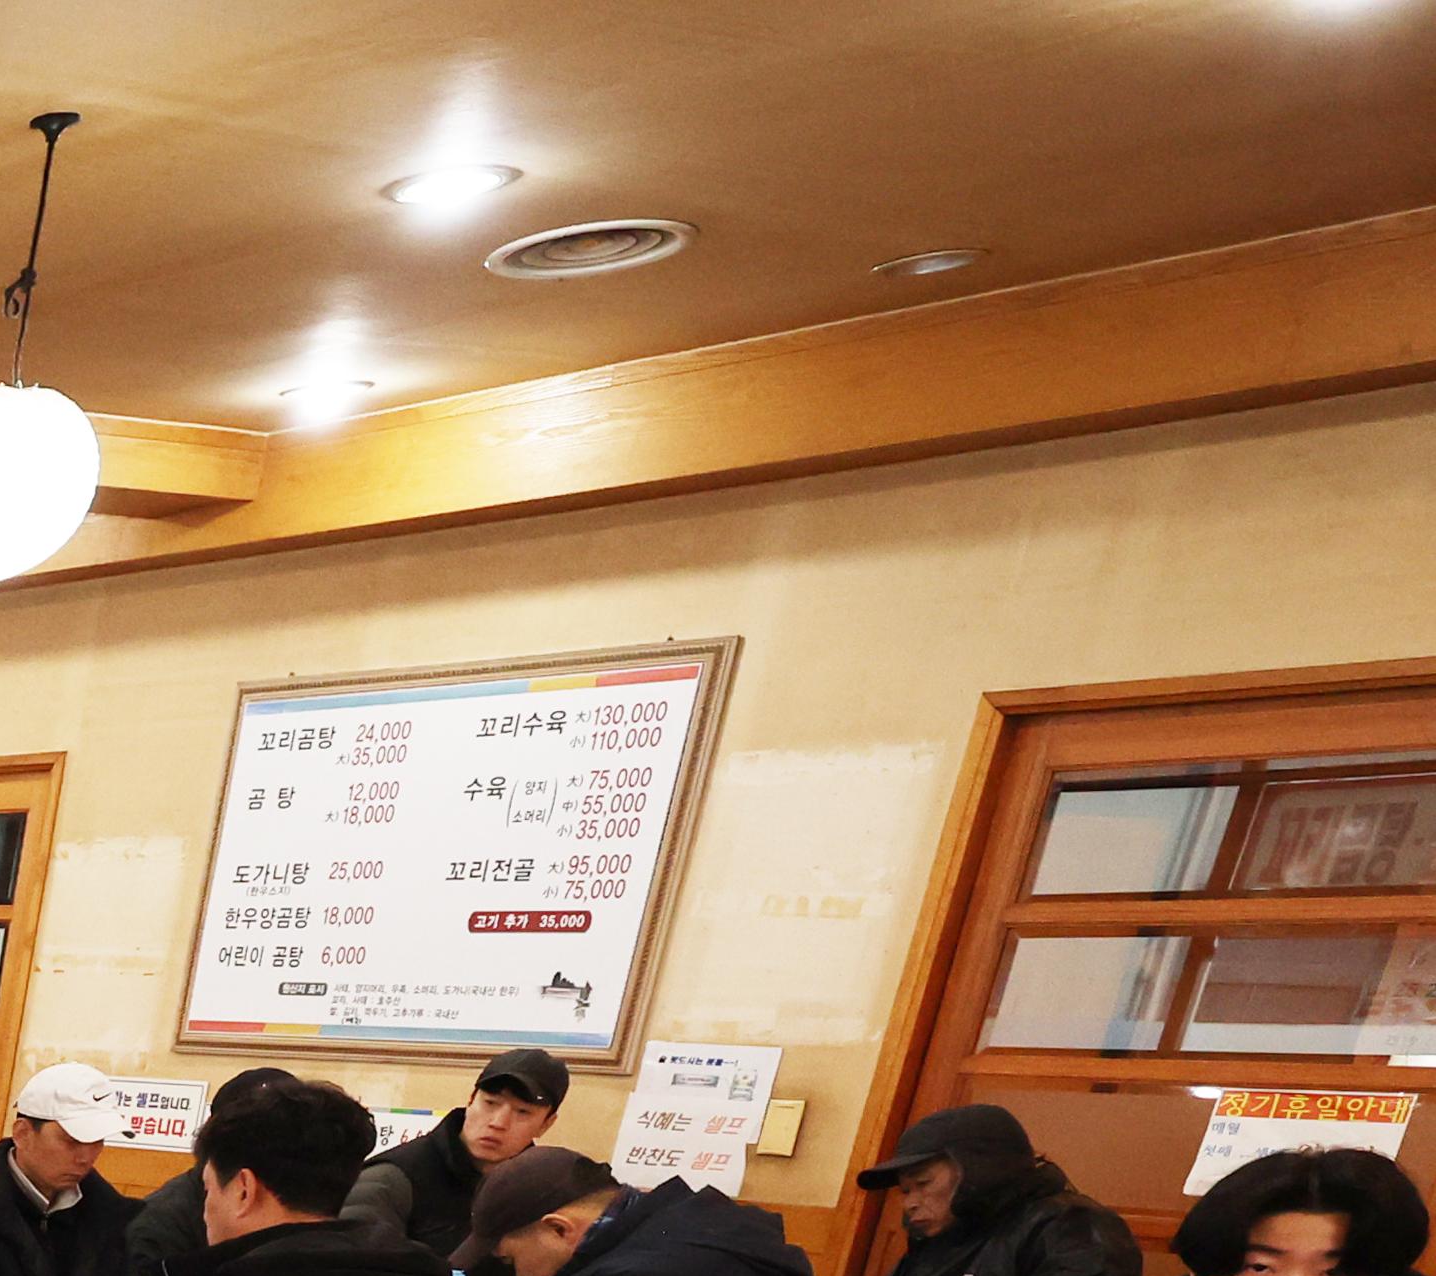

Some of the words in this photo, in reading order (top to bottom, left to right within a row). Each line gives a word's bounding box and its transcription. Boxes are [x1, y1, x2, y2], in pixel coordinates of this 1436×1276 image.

[476, 710, 568, 739] 꼬리수육
[593, 700, 669, 727] 130,000
[258, 726, 337, 752] 꼬리곰탕
[356, 720, 412, 743] 24,000
[591, 727, 662, 753] 110,000
[352, 744, 408, 767] 35,000
[348, 781, 400, 804] 12,000
[464, 776, 507, 801] 수육
[588, 767, 653, 792] 75,000
[343, 804, 395, 827] 18,000
[581, 792, 647, 817] 55,000
[575, 817, 641, 842] 35,000
[232, 862, 310, 885] 도가니탕
[329, 860, 384, 883] 25,000
[445, 858, 535, 883] 꼬리전골
[568, 854, 632, 878] 95,000
[564, 879, 626, 903] 75,000
[225, 906, 311, 930] 한우양곰탕
[323, 906, 374, 928] 18,000
[474, 915, 499, 928] 고기
[504, 915, 529, 929] 추가
[539, 915, 585, 929] 35,000
[218, 945, 264, 967] 어린이
[272, 945, 304, 968] 곰탕
[321, 946, 366, 967] 6,000
[1220, 1092, 1410, 1124] 정기휴일안내
[637, 1110, 693, 1132] 식혜는
[704, 1114, 748, 1135] 셀프
[625, 1145, 685, 1168] 반찬도
[691, 1151, 733, 1172] 셀프
